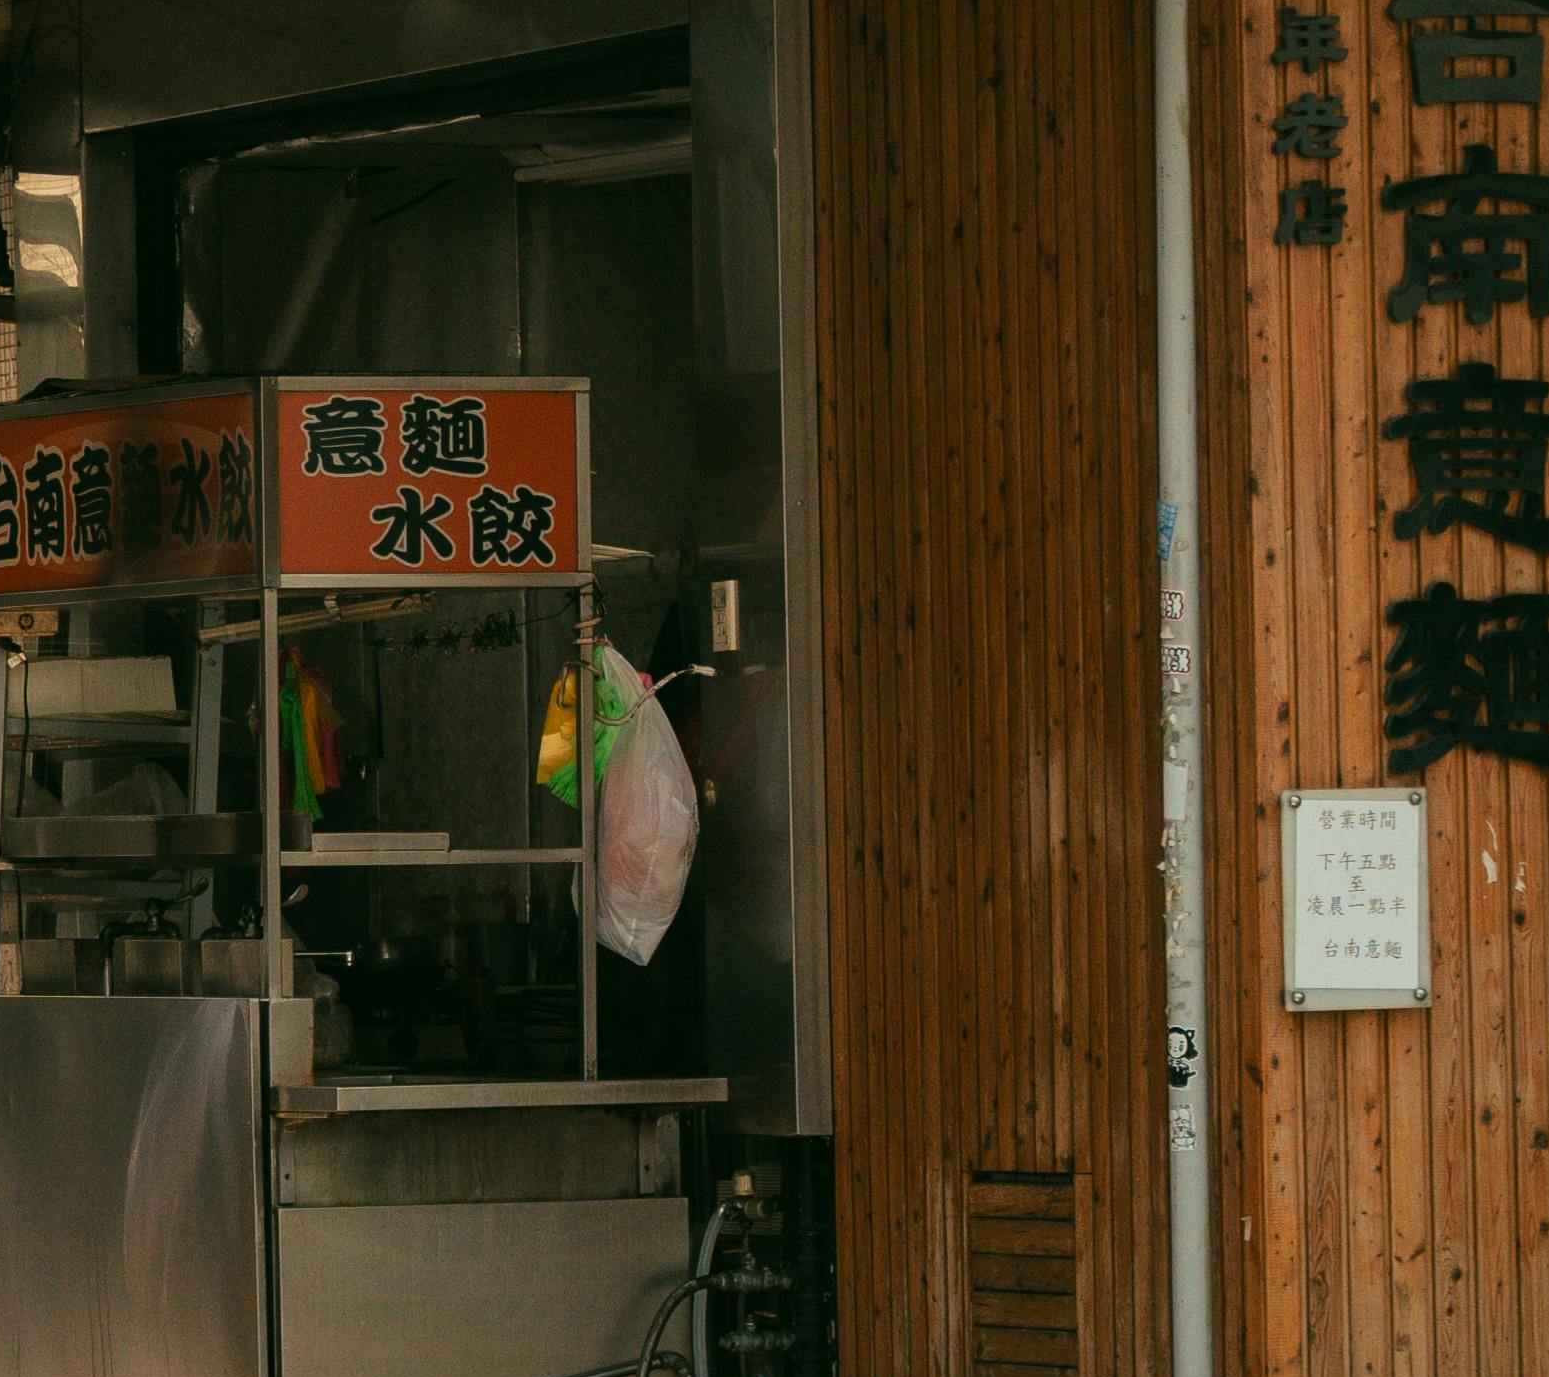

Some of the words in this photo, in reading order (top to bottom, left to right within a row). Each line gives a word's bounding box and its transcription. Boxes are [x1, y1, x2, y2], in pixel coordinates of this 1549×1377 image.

[302, 394, 487, 477] 意麵
[369, 484, 556, 568] 水餃
[1318, 810, 1397, 830] 營業時間
[1317, 852, 1397, 871] 下午五點
[1347, 875, 1367, 893] 至
[1306, 896, 1406, 917] 凌晨一點半
[1324, 937, 1405, 960] 台南意麵
